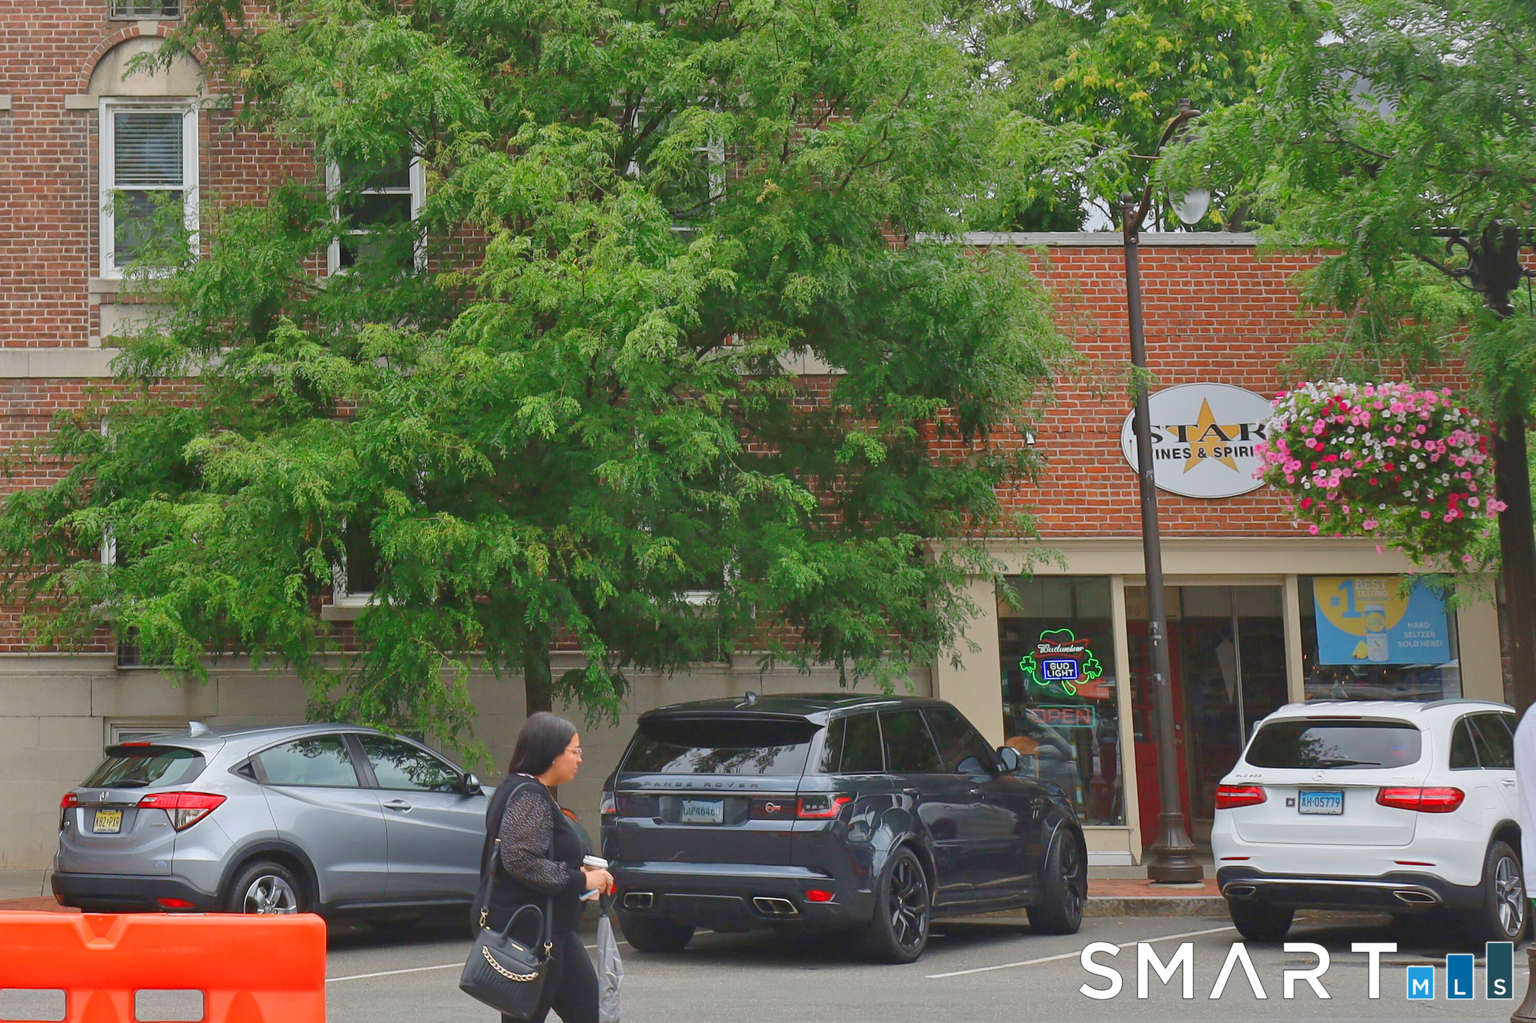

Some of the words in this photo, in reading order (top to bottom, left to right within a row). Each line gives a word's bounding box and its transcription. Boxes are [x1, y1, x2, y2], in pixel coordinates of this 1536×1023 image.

[1151, 448, 1192, 460] INES
[1197, 447, 1207, 458] &
[1213, 446, 1254, 458] SPIRI
[1355, 578, 1387, 590] BEST
[1356, 589, 1389, 597] TASTING
[1407, 621, 1430, 629] HARD
[1397, 640, 1419, 648] SOLD
[1031, 708, 1091, 724] OPEN
